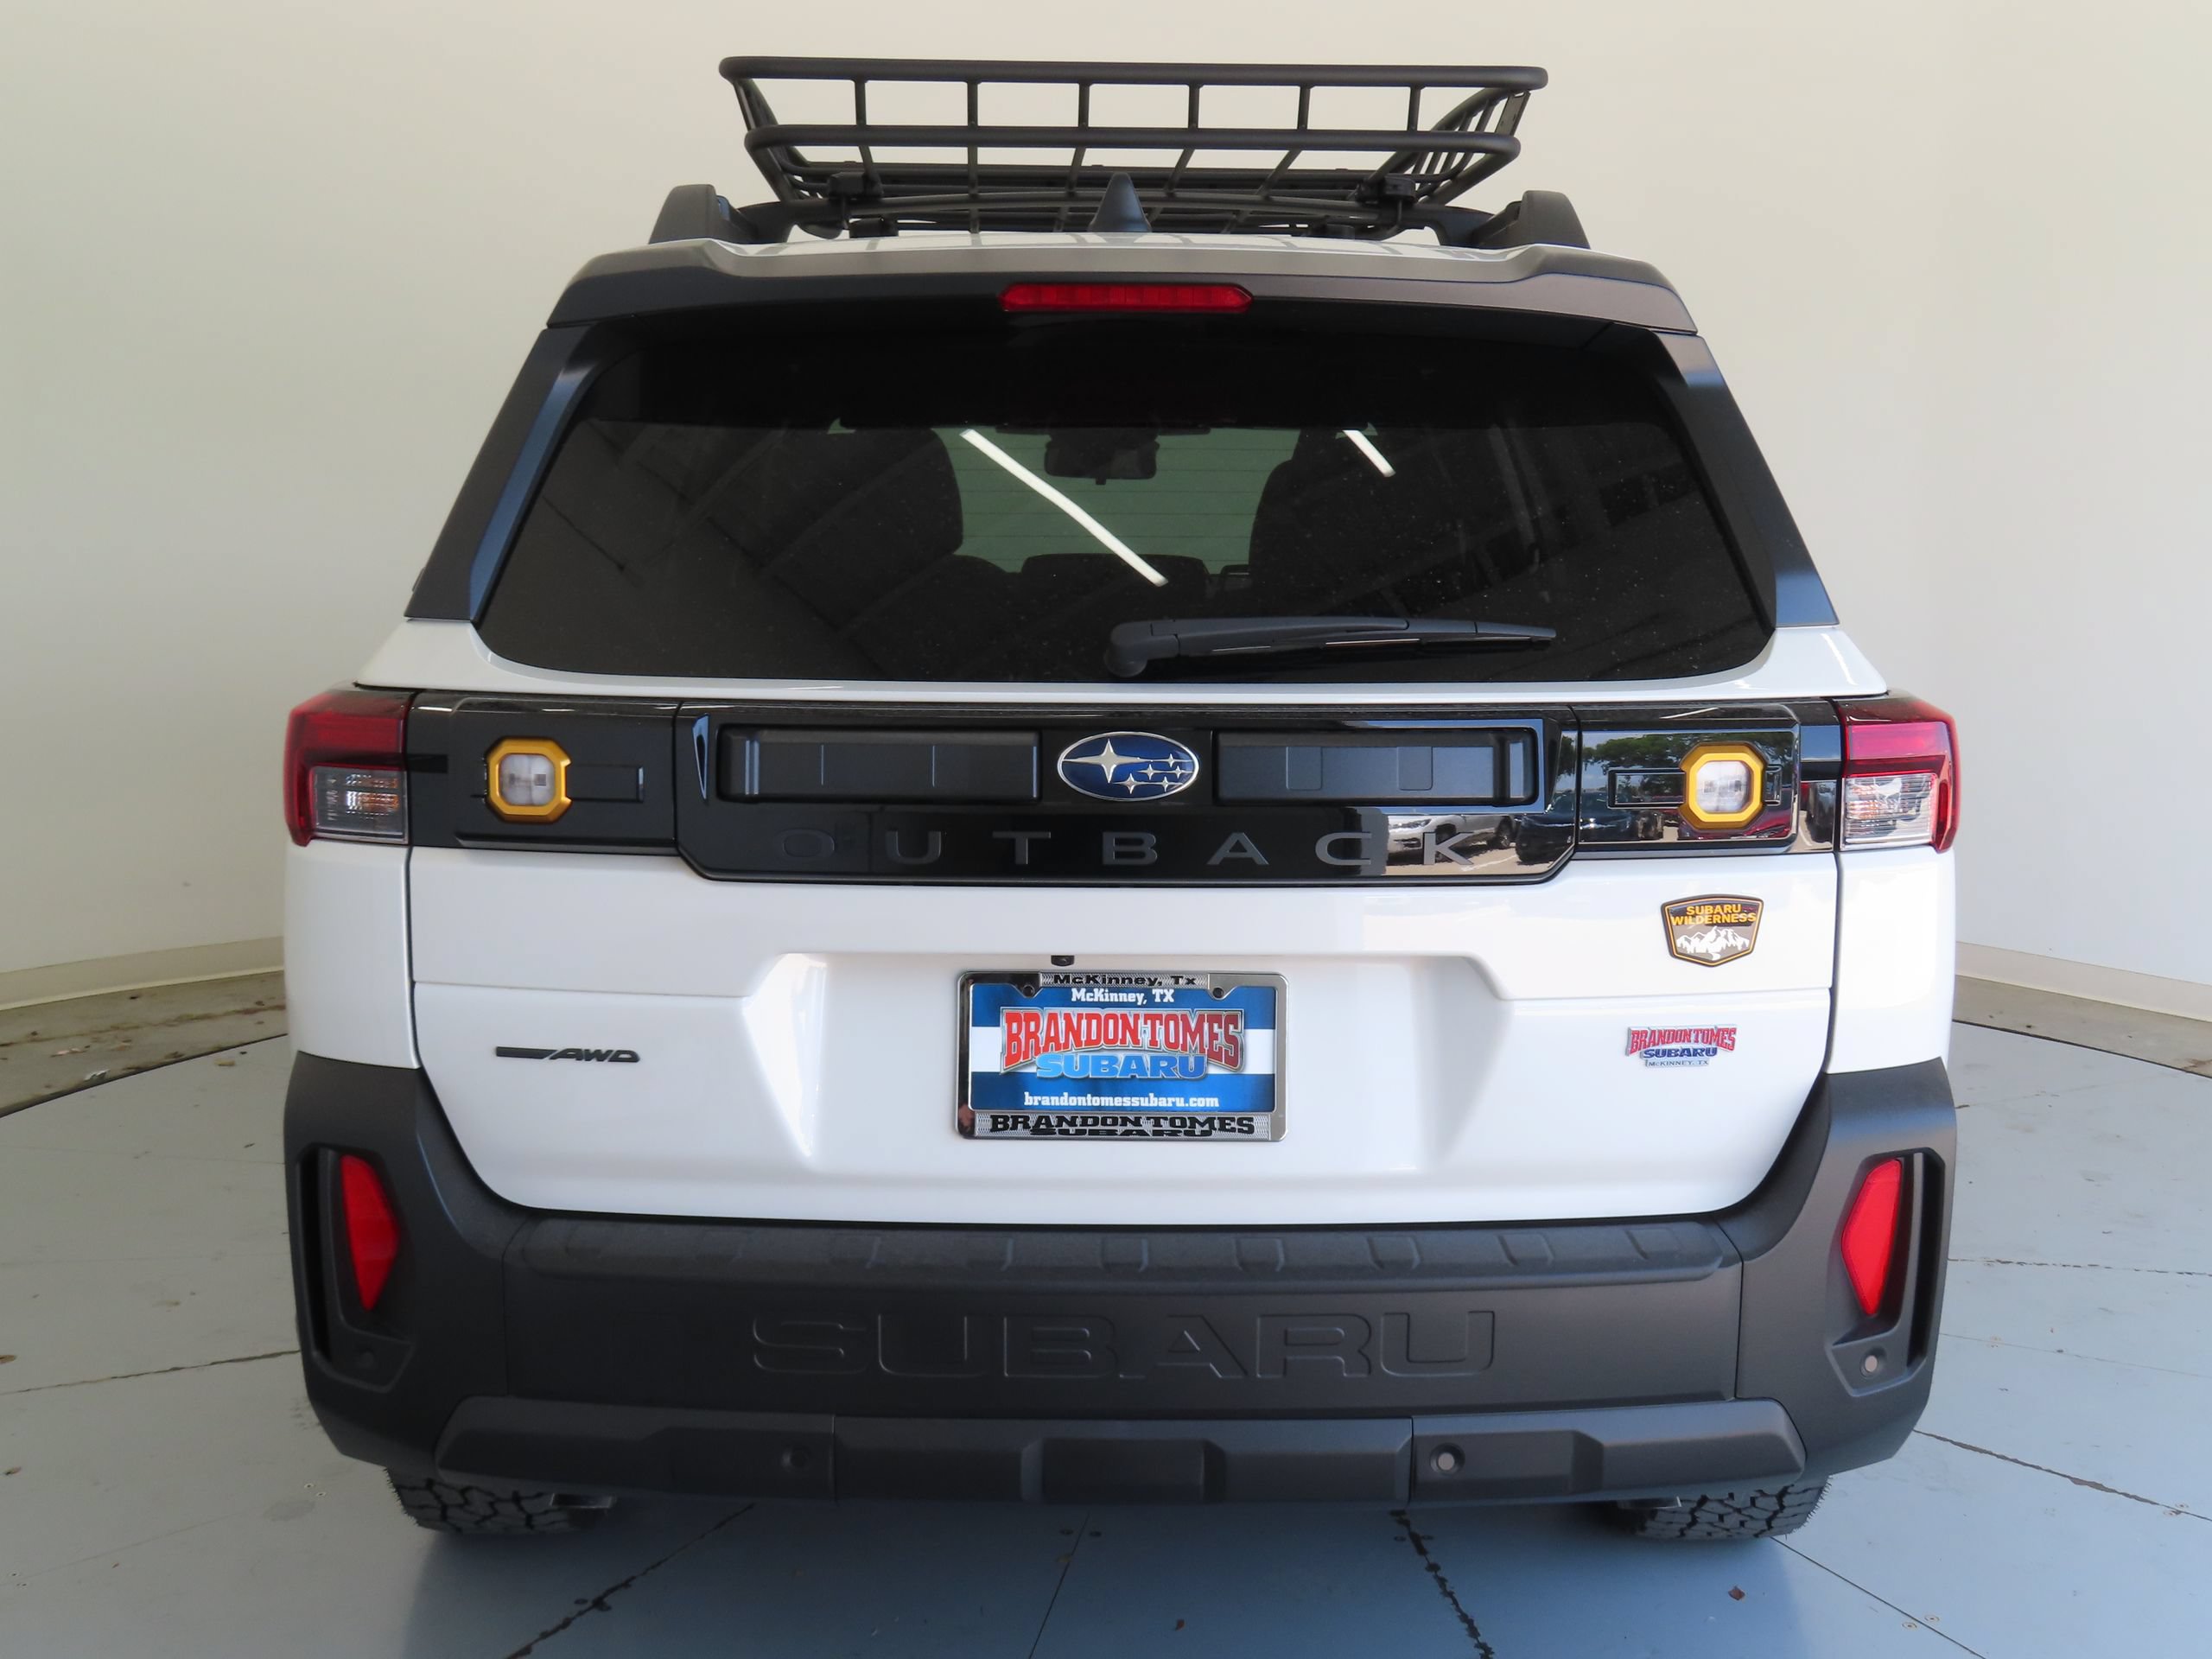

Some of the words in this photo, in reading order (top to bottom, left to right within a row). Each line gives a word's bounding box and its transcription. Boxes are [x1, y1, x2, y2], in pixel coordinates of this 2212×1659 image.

[782, 829, 1476, 868] OUTBACK
[1686, 904, 1742, 915] SUBARU
[1671, 912, 1758, 926] WILDERNESS
[1053, 974, 1163, 987] McKinney,
[1173, 976, 1197, 986] Tx
[1071, 988, 1147, 1005] McKinney,
[1152, 989, 1175, 1002] TX
[550, 1048, 640, 1063] AWD
[1643, 1047, 1719, 1058] SUBARU
[1036, 1053, 1208, 1079] SUBARU
[1024, 1092, 1219, 1108] brandontomessubaru.com
[1030, 1128, 1213, 1137] SUBARU
[752, 1310, 1496, 1380] SUBARU
